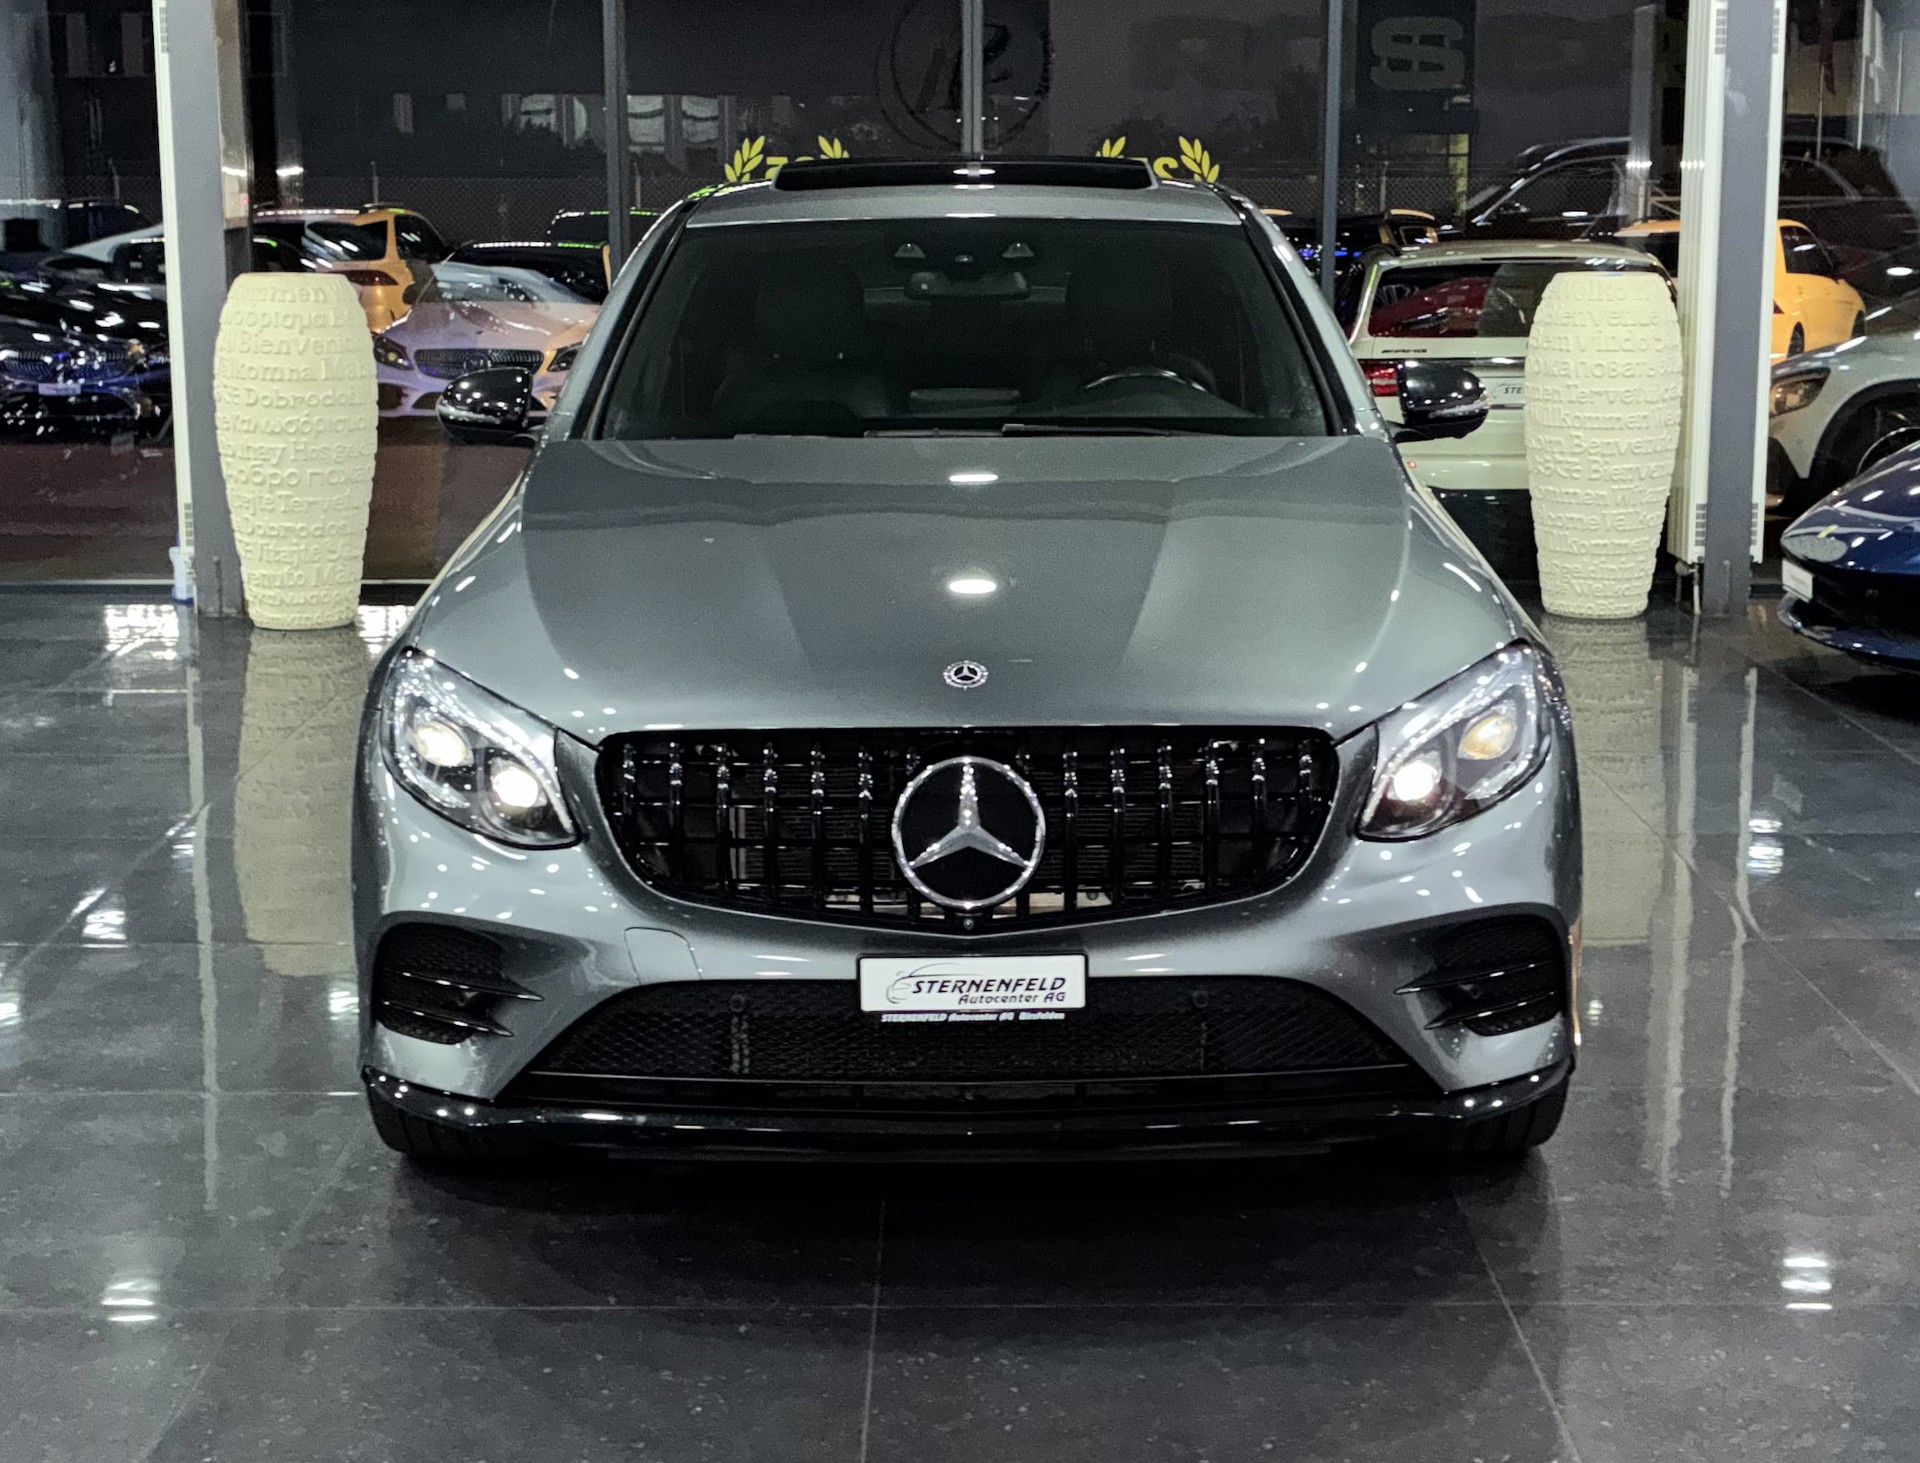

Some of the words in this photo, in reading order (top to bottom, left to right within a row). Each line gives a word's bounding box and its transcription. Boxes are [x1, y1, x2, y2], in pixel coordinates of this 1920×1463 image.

[912, 977, 1066, 994] STERNENFELD
[958, 993, 1039, 1005] Autocenter
[1044, 992, 1066, 1003] AG
